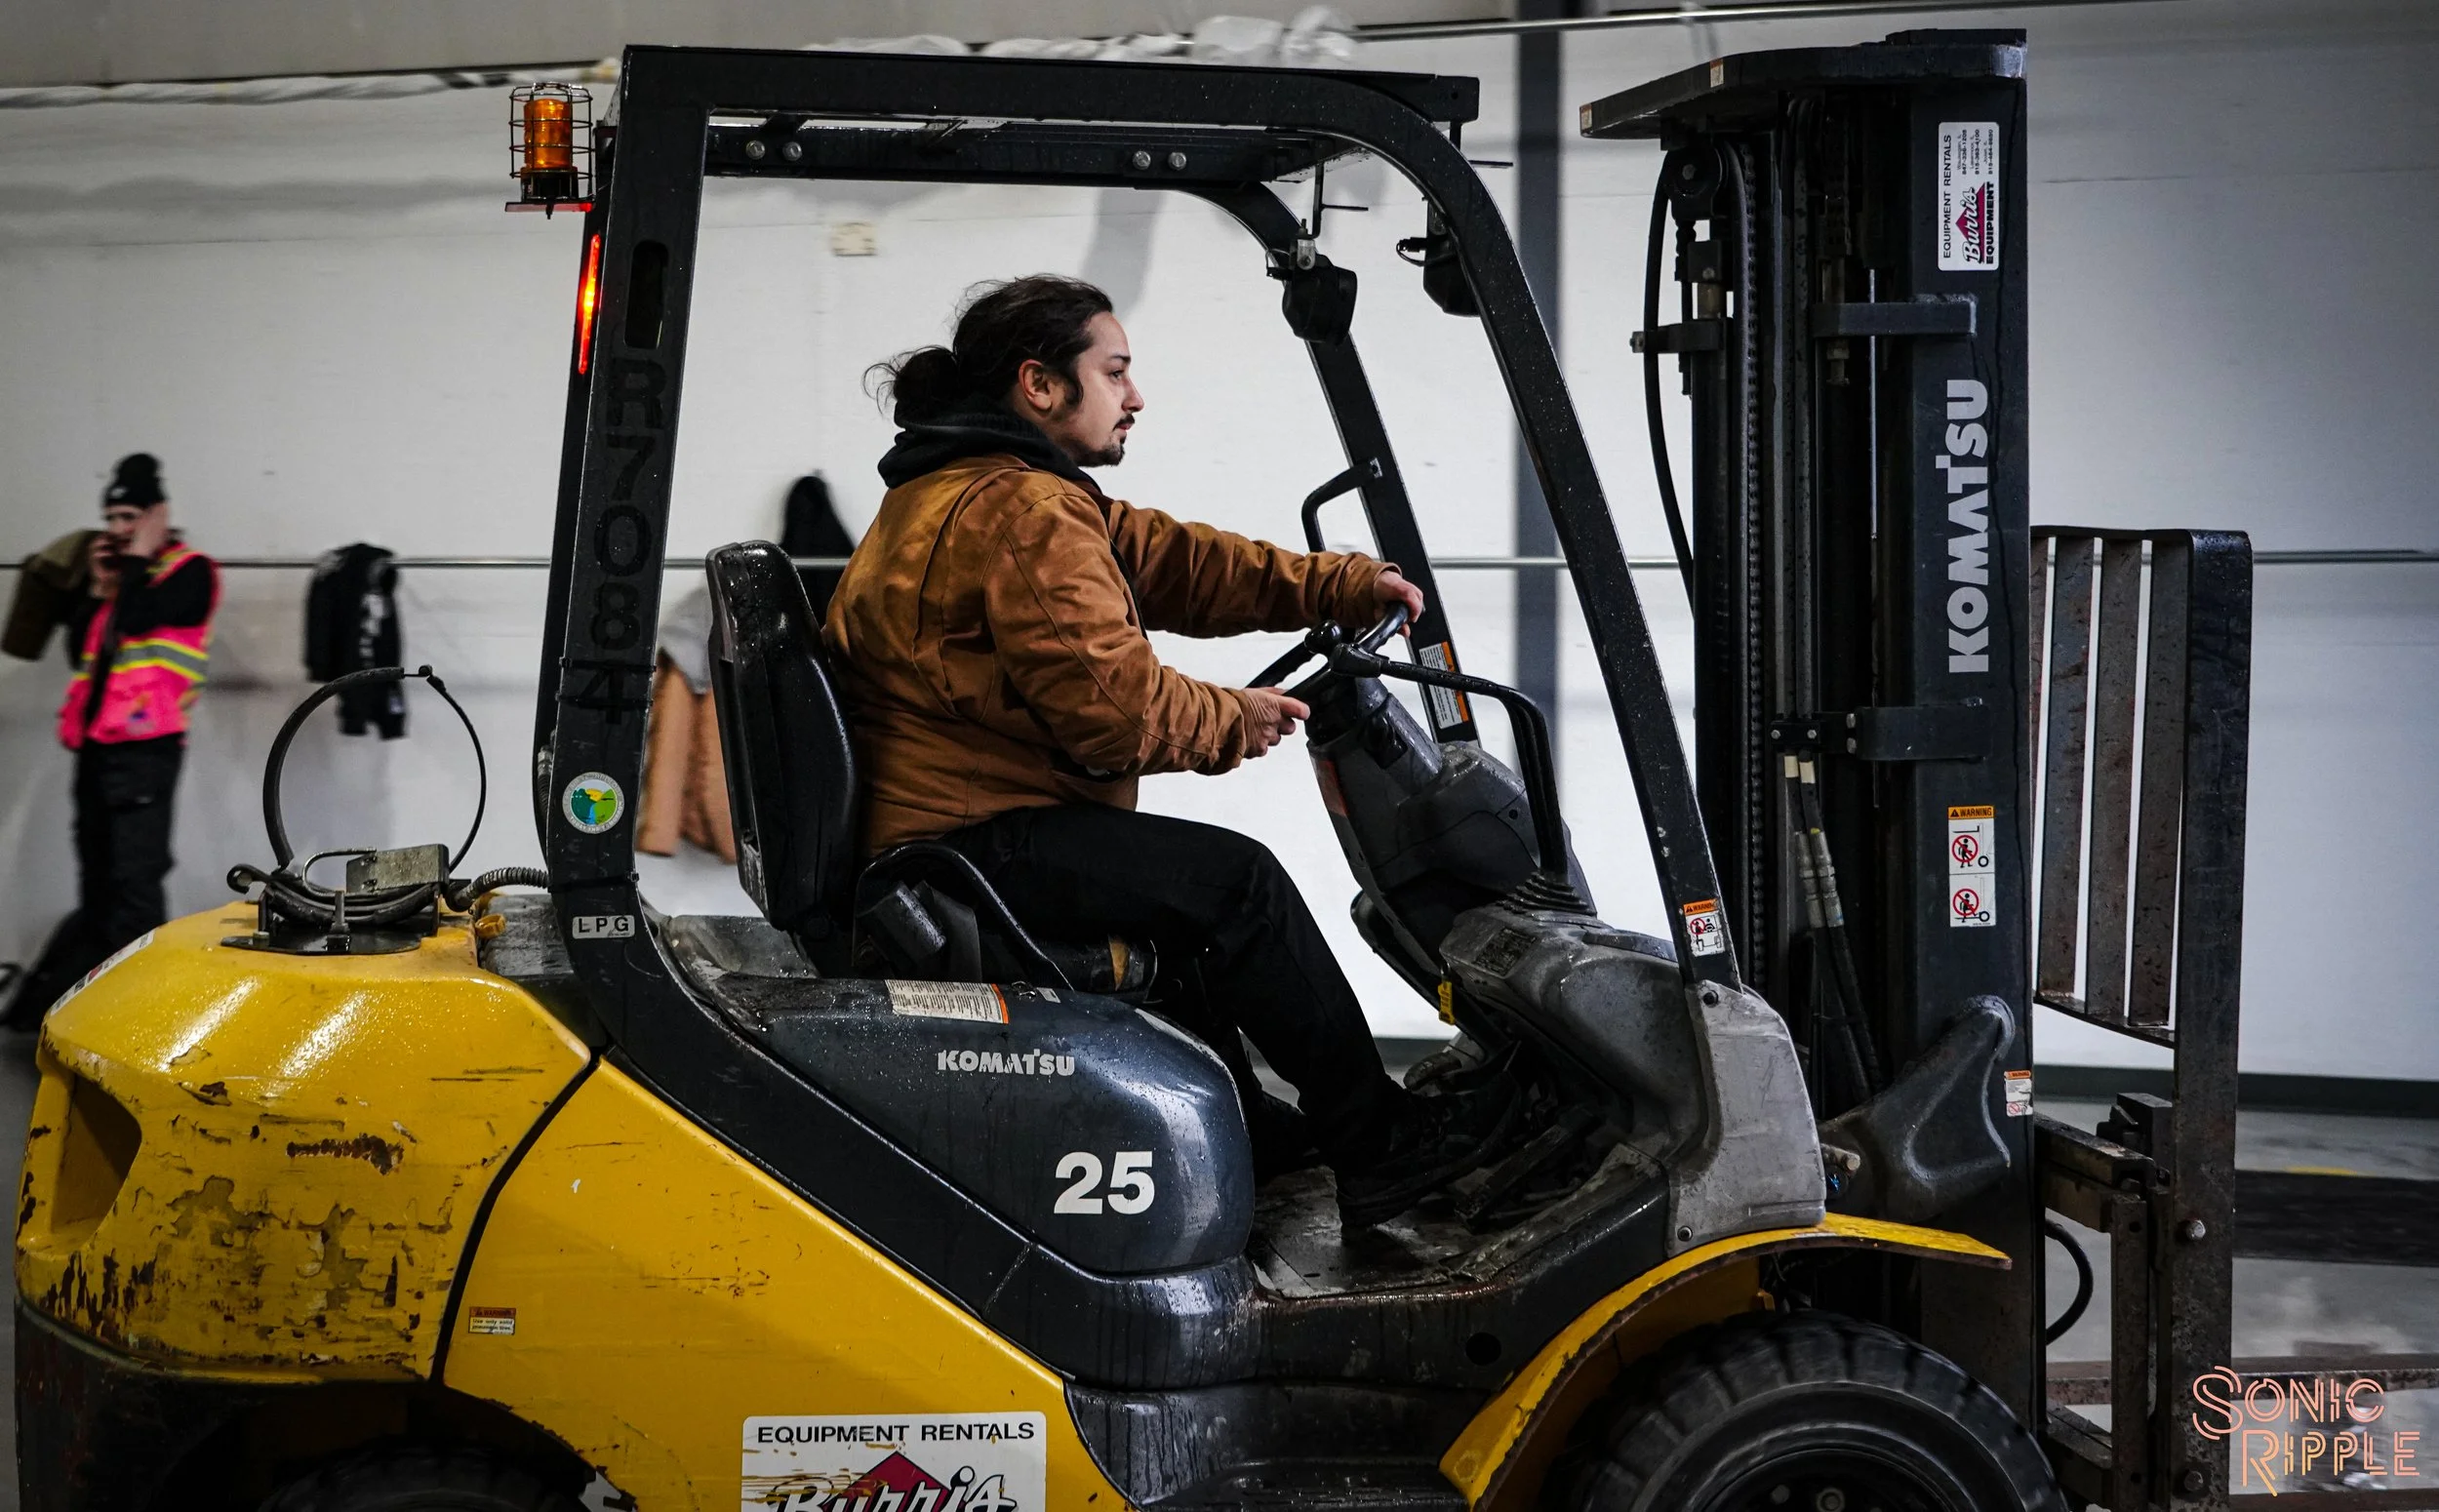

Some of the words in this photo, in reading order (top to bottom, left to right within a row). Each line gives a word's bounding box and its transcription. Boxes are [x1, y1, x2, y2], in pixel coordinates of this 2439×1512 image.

[1960, 186, 1981, 264] Burris
[1936, 379, 1989, 672] KOMATSU
[1960, 808, 1992, 816] WARNING
[578, 917, 629, 934] LPG
[937, 1049, 1075, 1076] KOMATSU
[1054, 1151, 1155, 1214] 25
[757, 1424, 909, 1444] EQUIPMENT
[921, 1422, 1034, 1442] RENTALS
